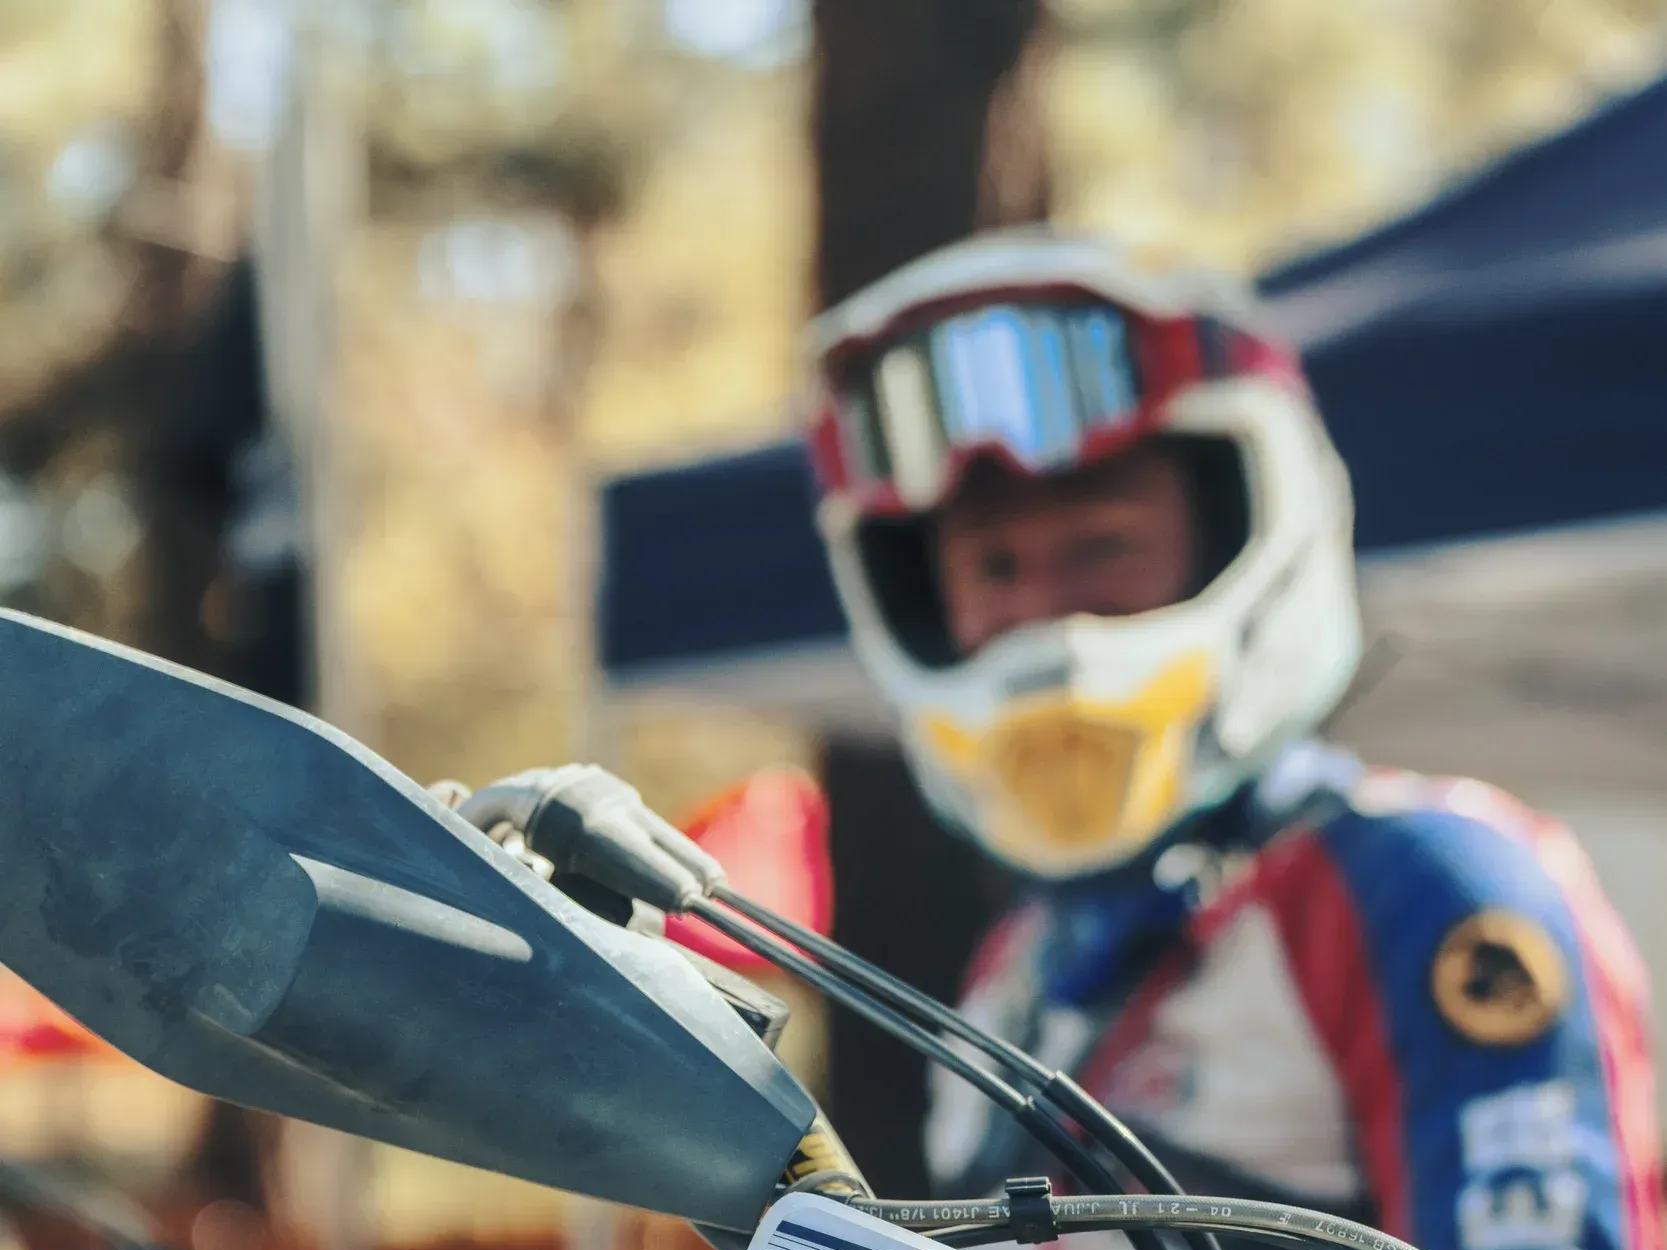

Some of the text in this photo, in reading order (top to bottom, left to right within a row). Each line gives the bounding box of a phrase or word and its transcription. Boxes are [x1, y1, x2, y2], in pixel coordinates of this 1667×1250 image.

[933, 1206, 980, 1220] J1401
[1049, 1202, 1100, 1216] J.JUA
[1210, 1206, 1232, 1218] 04
